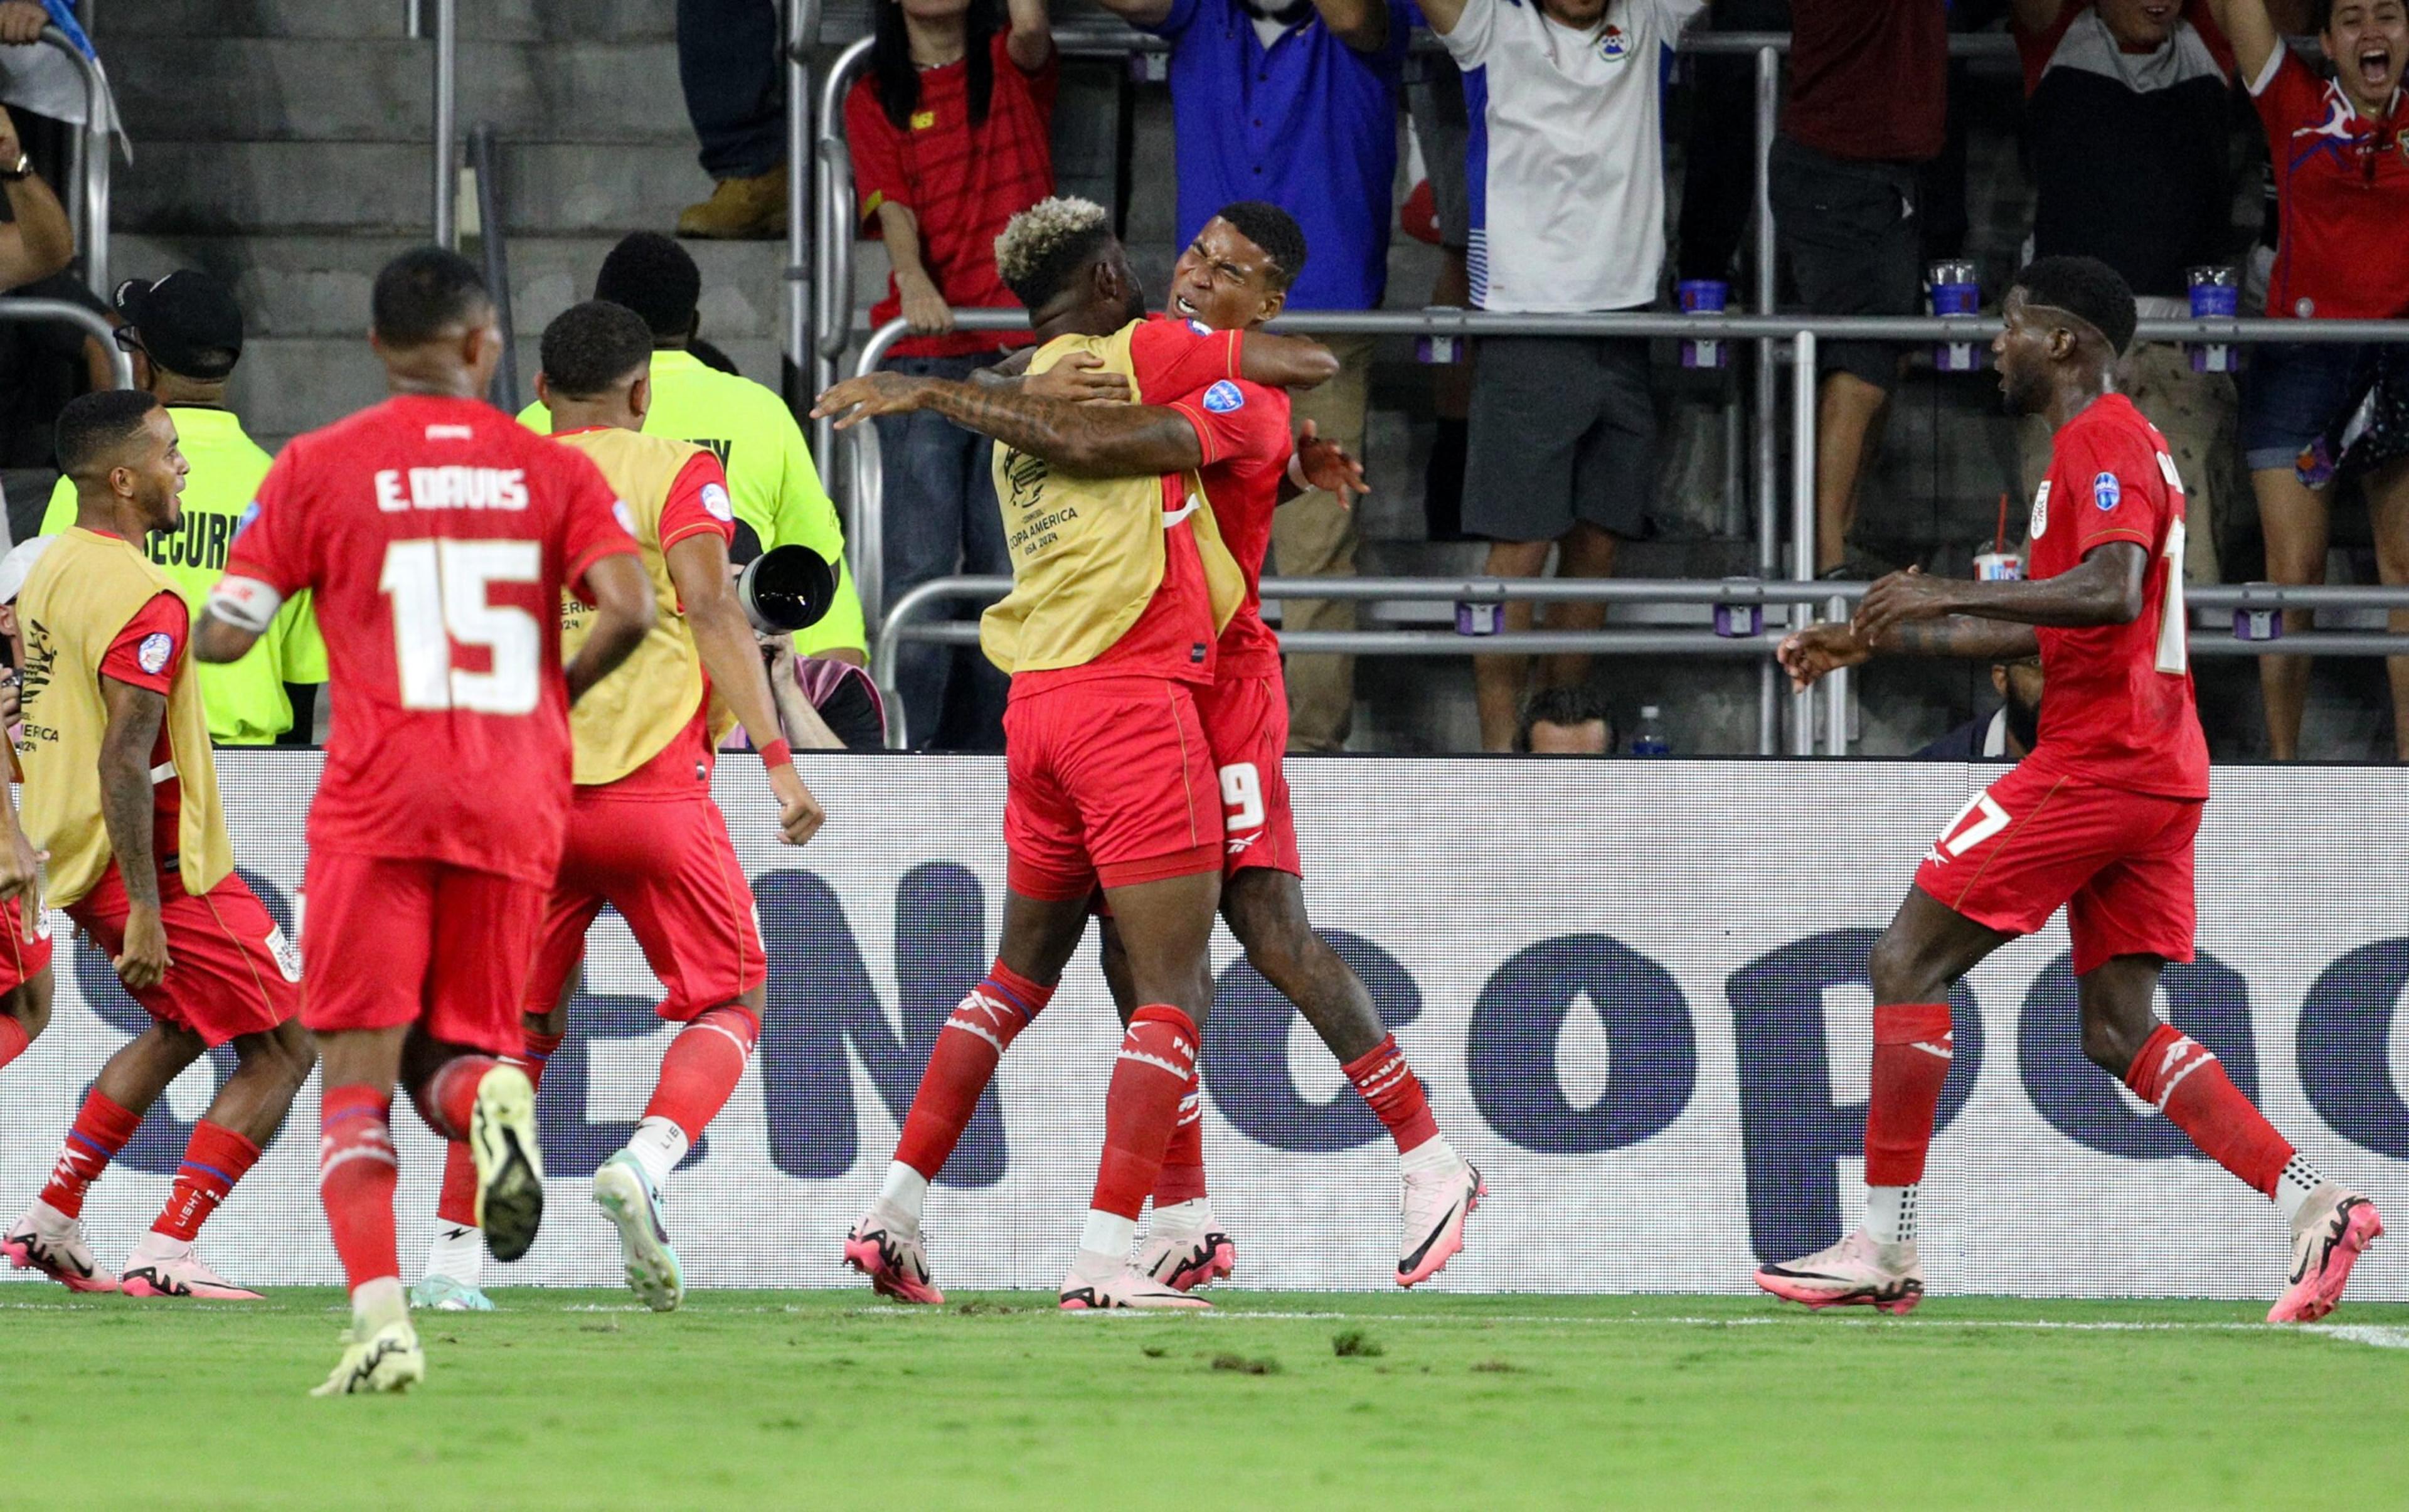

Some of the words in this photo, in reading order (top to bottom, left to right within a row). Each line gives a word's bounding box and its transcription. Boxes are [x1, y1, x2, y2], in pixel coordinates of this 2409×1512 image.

[1029, 507, 1078, 539] AMERICA
[378, 536, 542, 715] 15
[1219, 762, 1265, 831] 9
[1937, 788, 2013, 858] 17
